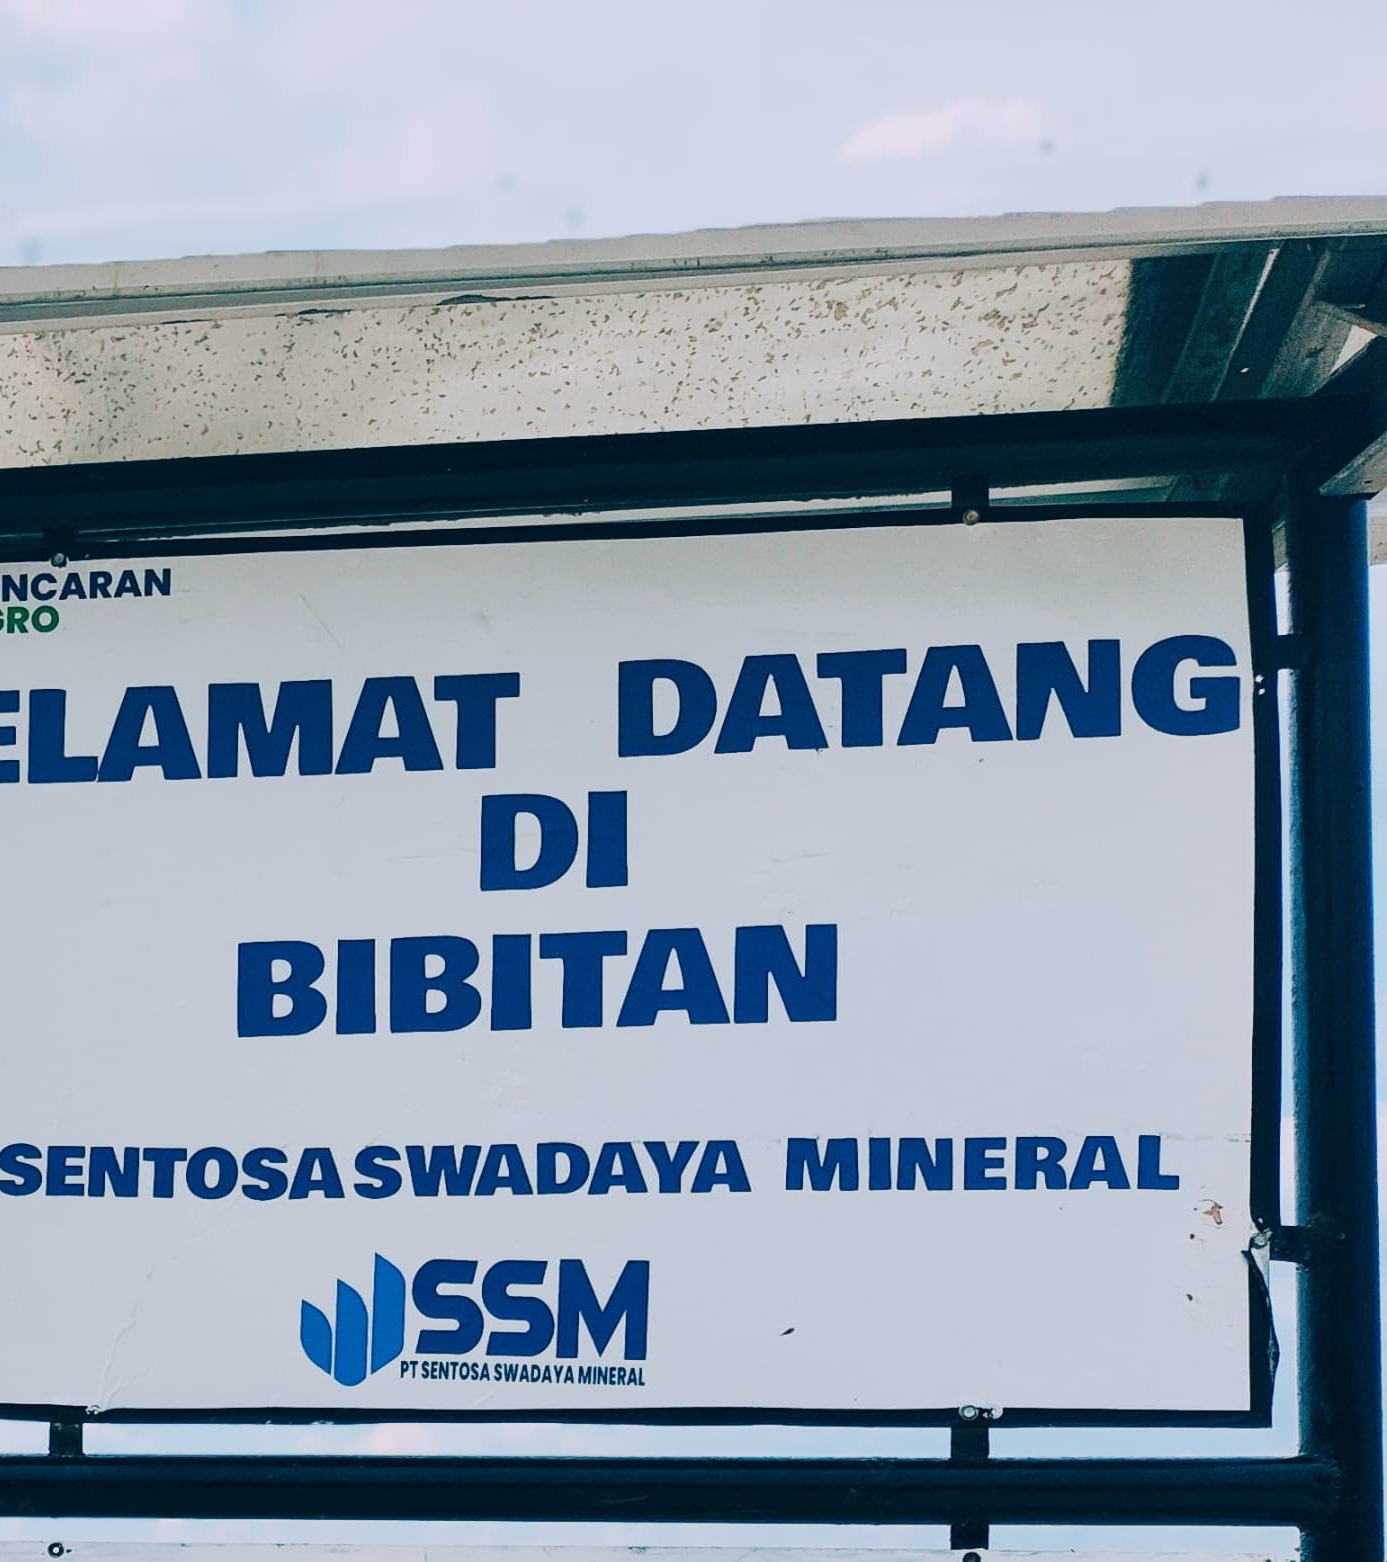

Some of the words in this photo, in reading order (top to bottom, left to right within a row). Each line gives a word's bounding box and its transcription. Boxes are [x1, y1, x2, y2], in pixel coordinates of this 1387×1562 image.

[617, 634, 1241, 758] DATANG
[479, 790, 629, 892] DI
[236, 923, 838, 1038] BIBITAN
[785, 1134, 1180, 1192] MINERAL
[411, 1258, 650, 1361] SSM
[400, 1360, 419, 1379] PT
[421, 1360, 491, 1382] SENTOSA
[493, 1362, 575, 1385] SWADAYA
[577, 1365, 646, 1387] MINERAL
